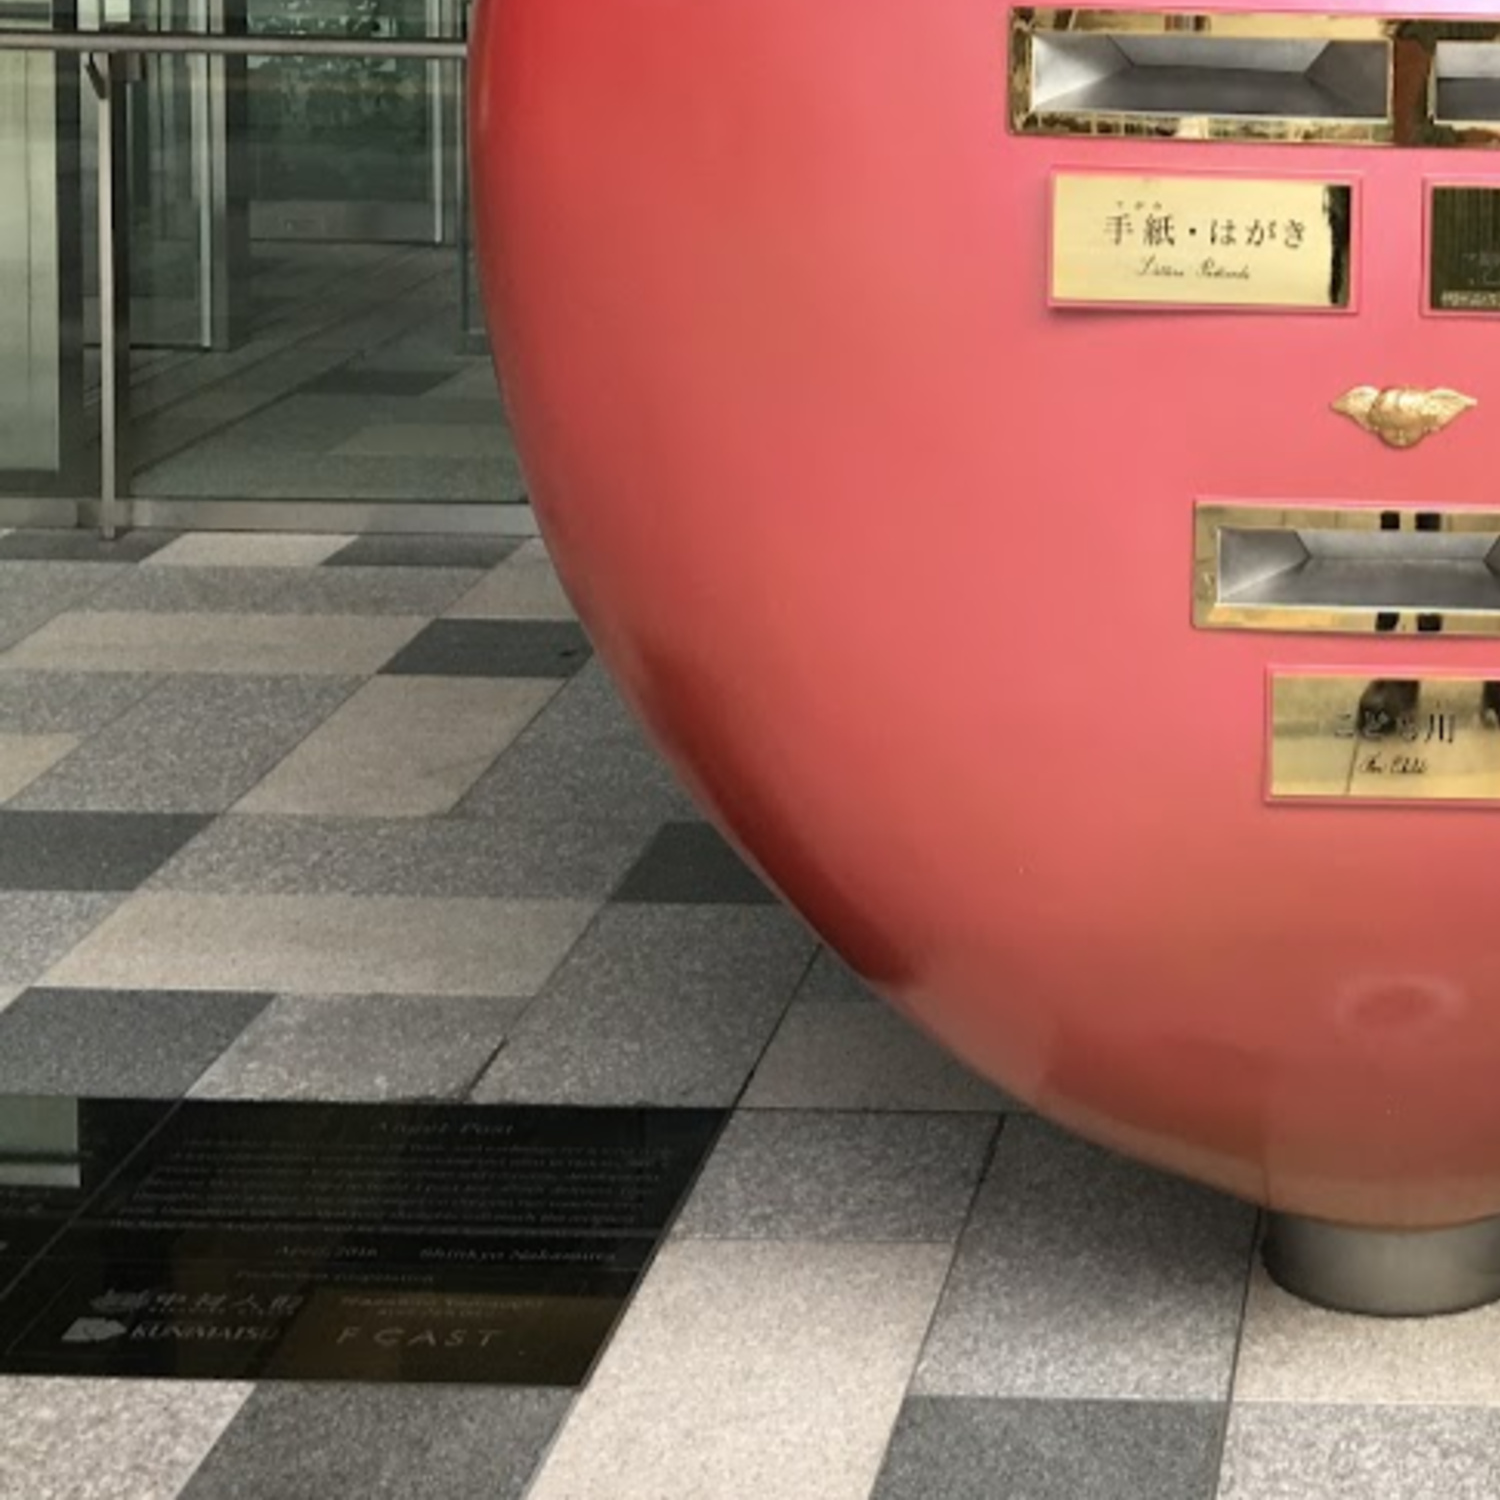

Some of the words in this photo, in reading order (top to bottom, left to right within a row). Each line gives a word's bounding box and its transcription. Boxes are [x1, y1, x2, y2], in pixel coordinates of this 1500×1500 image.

[1103, 213, 1306, 250] 手紙・はがき
